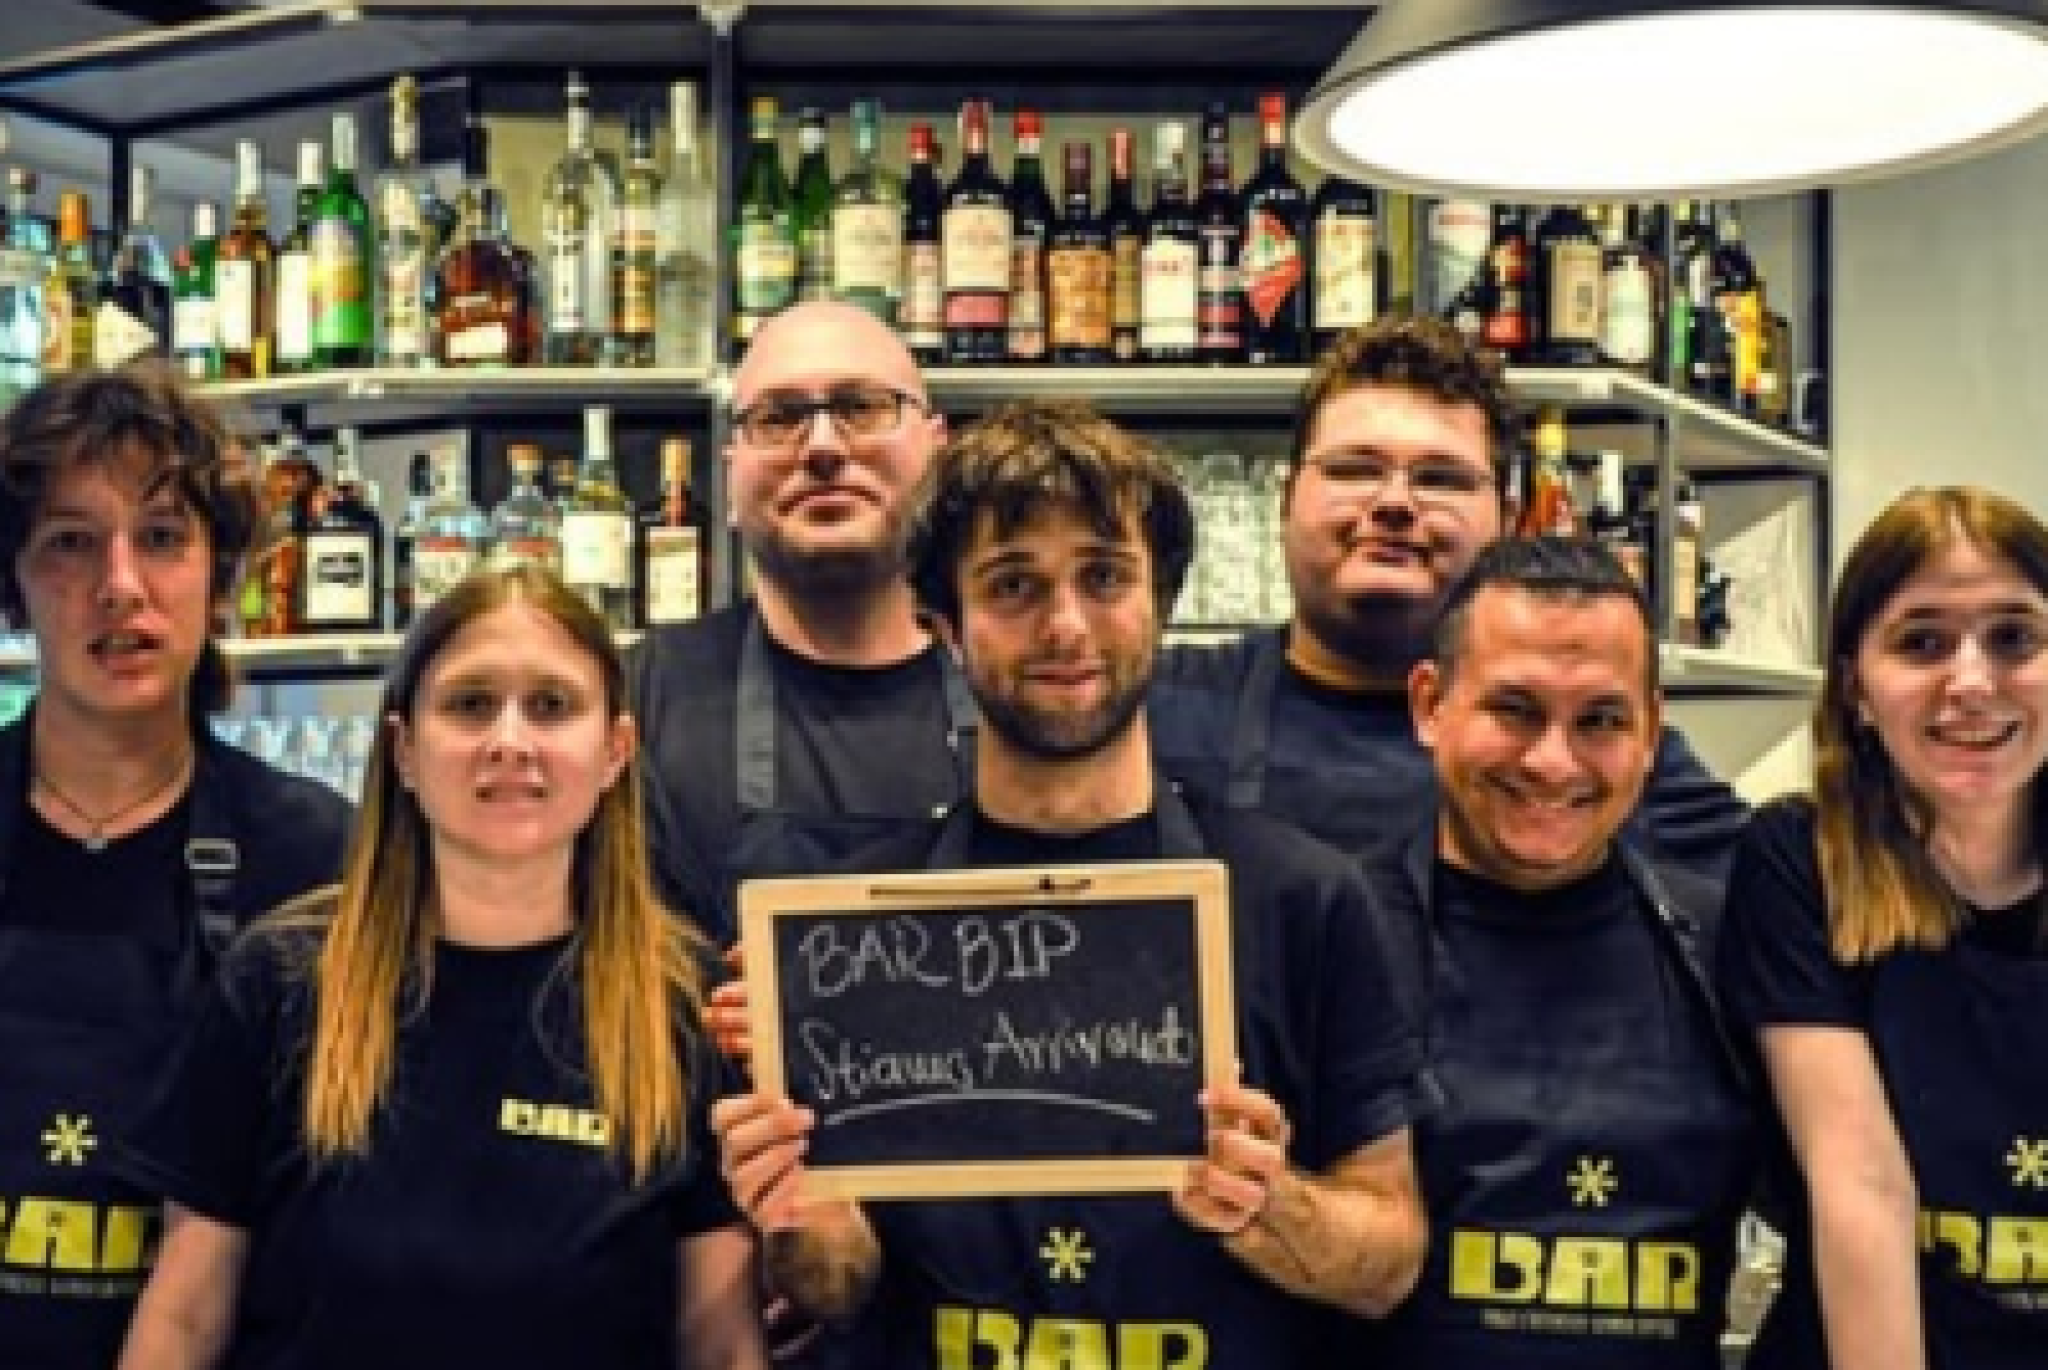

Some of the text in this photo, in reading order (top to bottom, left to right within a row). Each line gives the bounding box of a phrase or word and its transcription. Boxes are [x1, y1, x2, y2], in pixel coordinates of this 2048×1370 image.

[798, 910, 1081, 997] BAR BIP
[1450, 1231, 1699, 1314] BAR
[934, 1305, 1210, 1370] BAR
